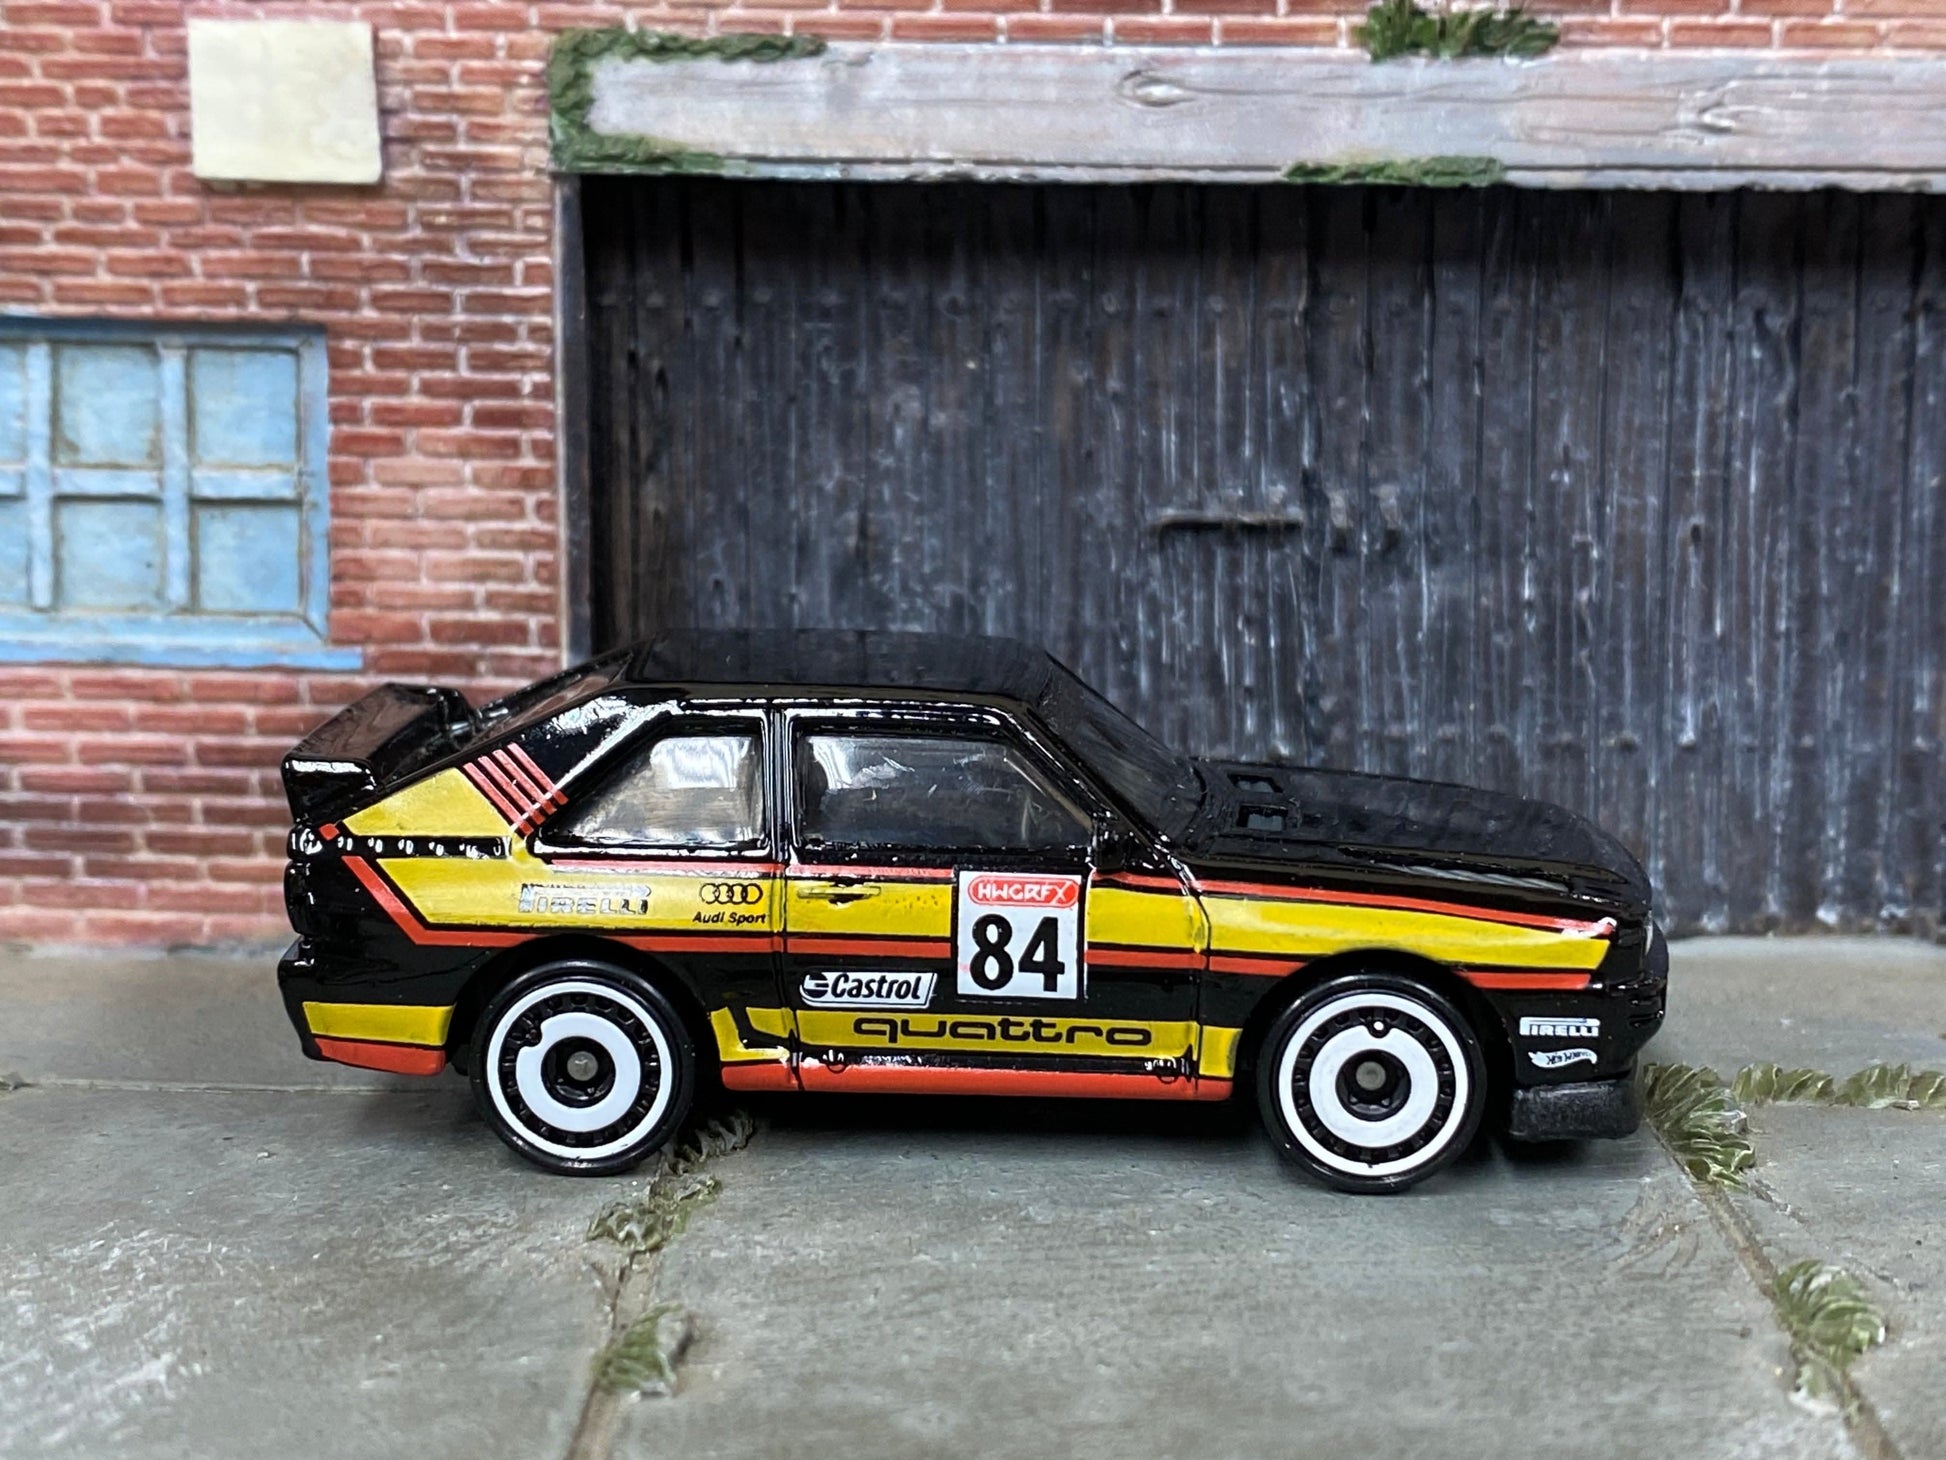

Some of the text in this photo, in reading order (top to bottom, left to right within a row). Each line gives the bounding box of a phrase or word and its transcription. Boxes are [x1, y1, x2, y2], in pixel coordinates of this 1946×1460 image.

[519, 883, 652, 914] PIRELLI
[977, 881, 1072, 904] HWGRFX
[693, 911, 766, 926] Audi Sport
[969, 913, 1065, 992] 84
[830, 971, 921, 1000] Castrol
[854, 1017, 1151, 1046] quattro
[1519, 1016, 1601, 1037] PIRELLI
